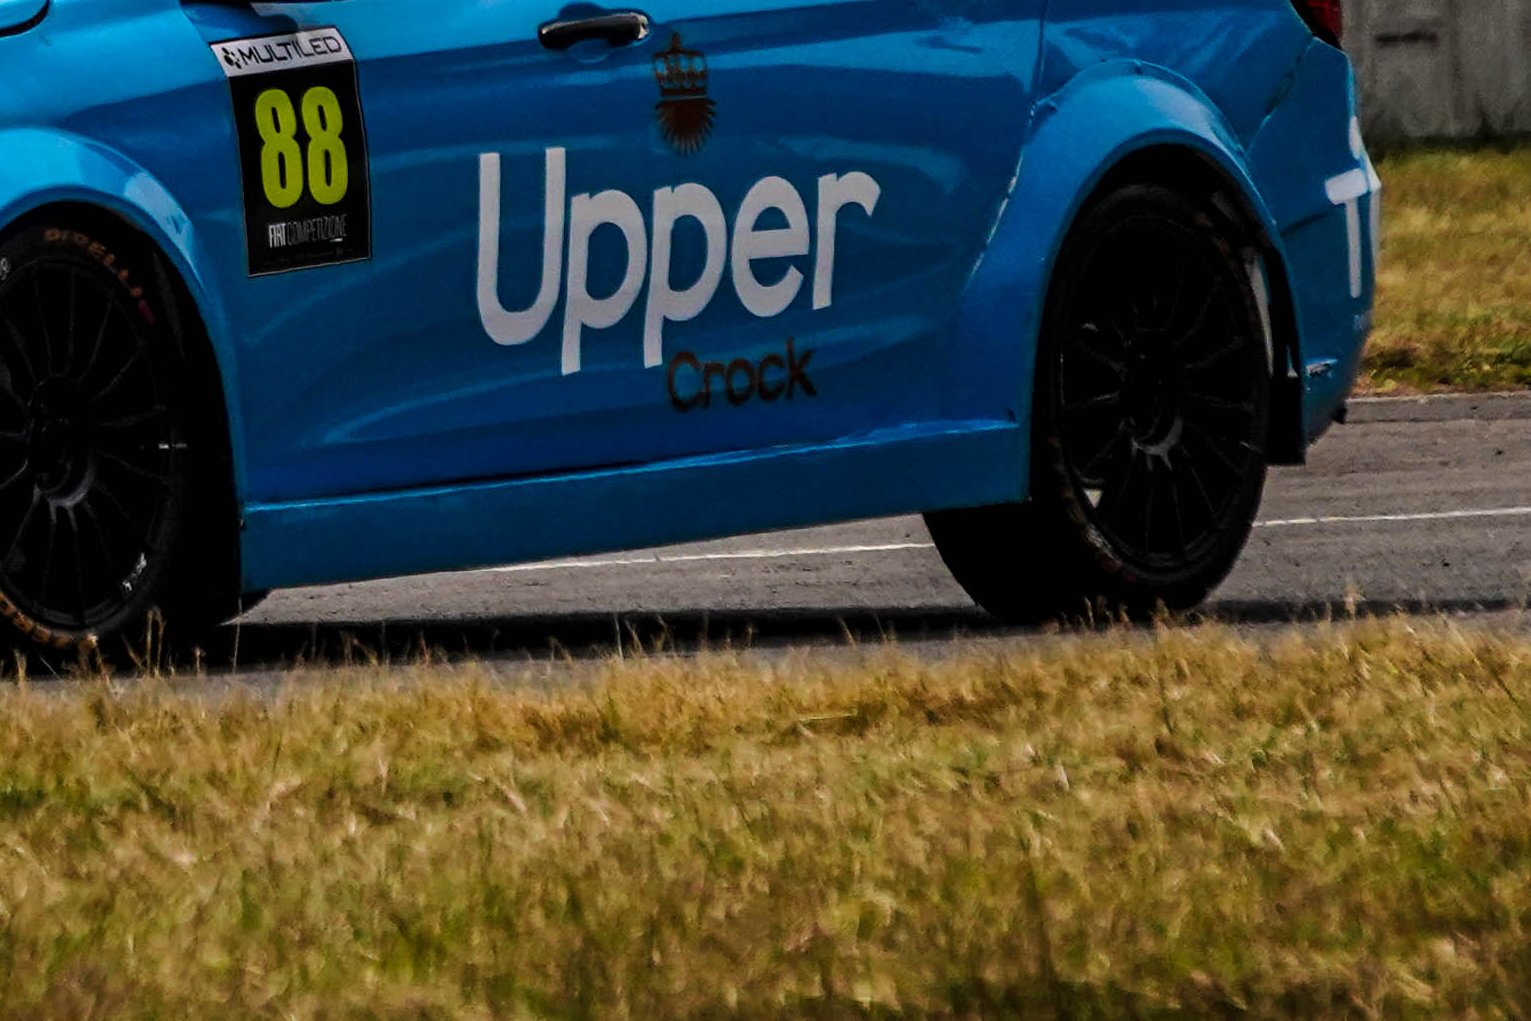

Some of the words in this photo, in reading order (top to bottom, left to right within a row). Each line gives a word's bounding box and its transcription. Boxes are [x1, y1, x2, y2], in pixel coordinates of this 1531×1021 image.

[239, 35, 343, 66] MULTILED
[254, 85, 349, 209] 88
[476, 146, 882, 376] Upper
[668, 336, 818, 412] Crock
